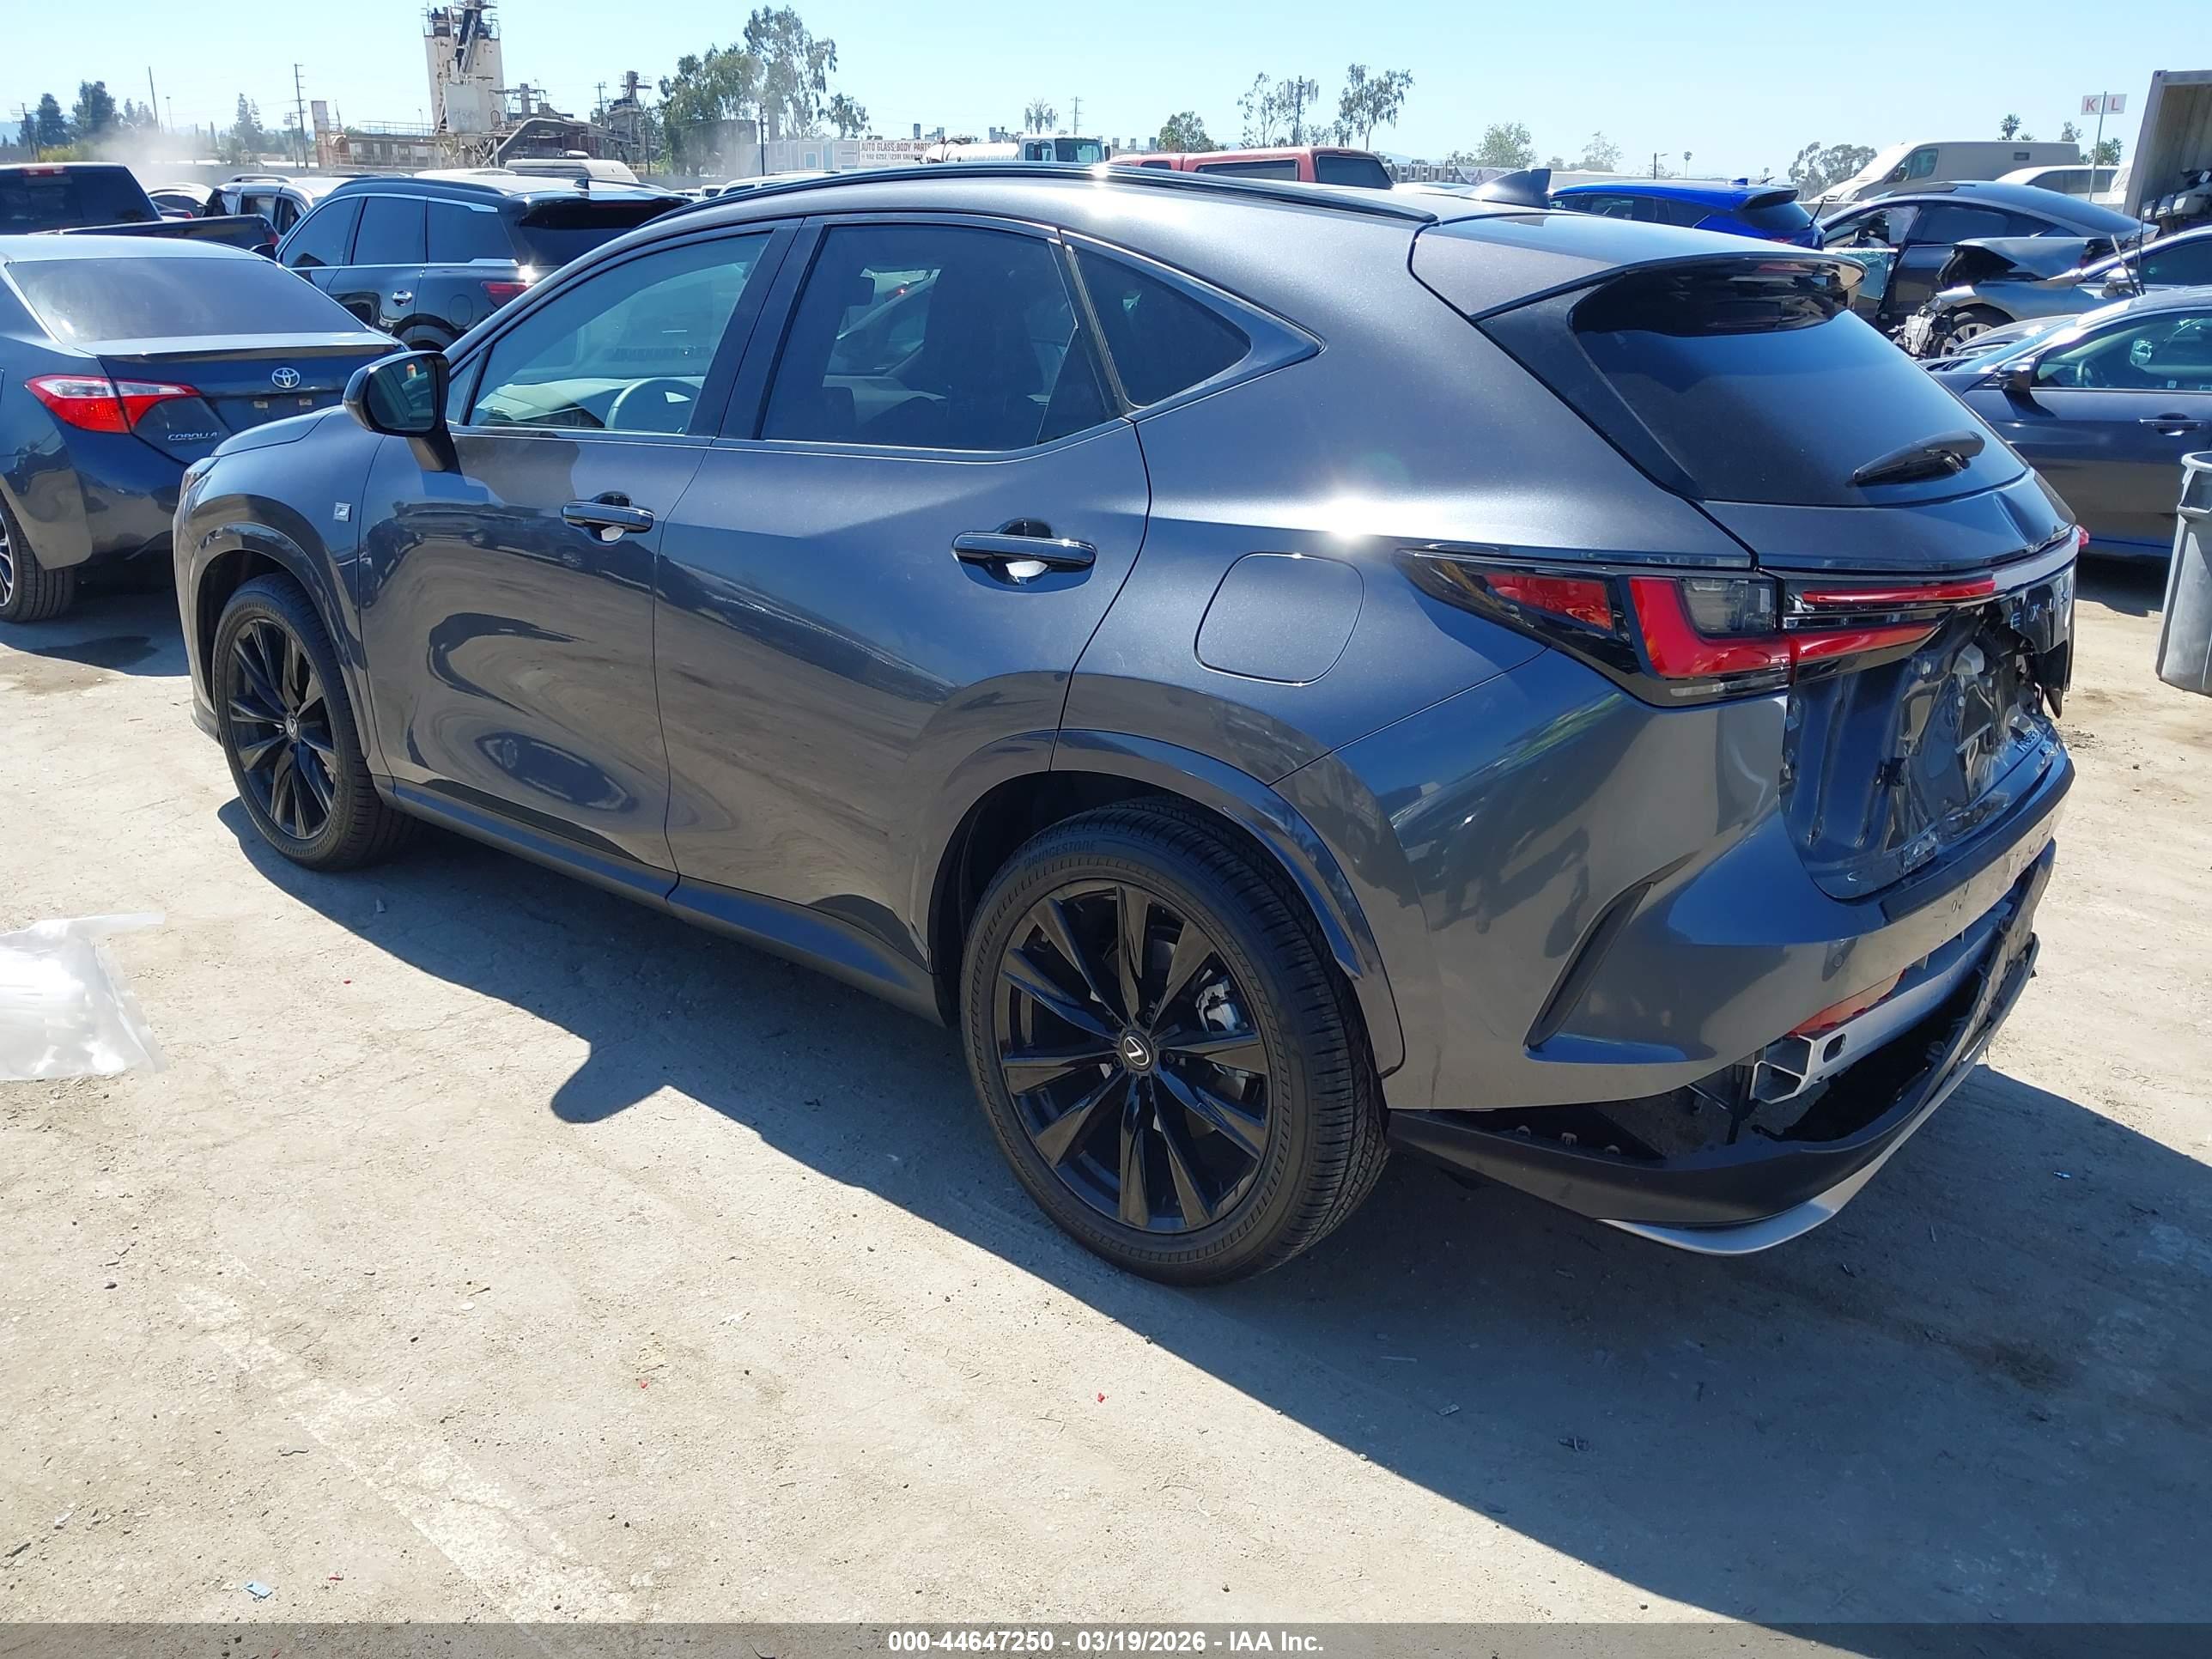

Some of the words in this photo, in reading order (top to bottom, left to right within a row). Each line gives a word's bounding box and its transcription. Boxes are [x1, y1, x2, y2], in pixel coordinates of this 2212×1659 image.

[2085, 98, 2097, 112] K
[2111, 97, 2120, 111] L
[860, 143, 876, 152] AUTO
[896, 143, 911, 152] BODY
[913, 143, 932, 152] PARTS
[167, 431, 218, 441] COROLLA
[1024, 840, 1097, 870] BRIDGESTONE
